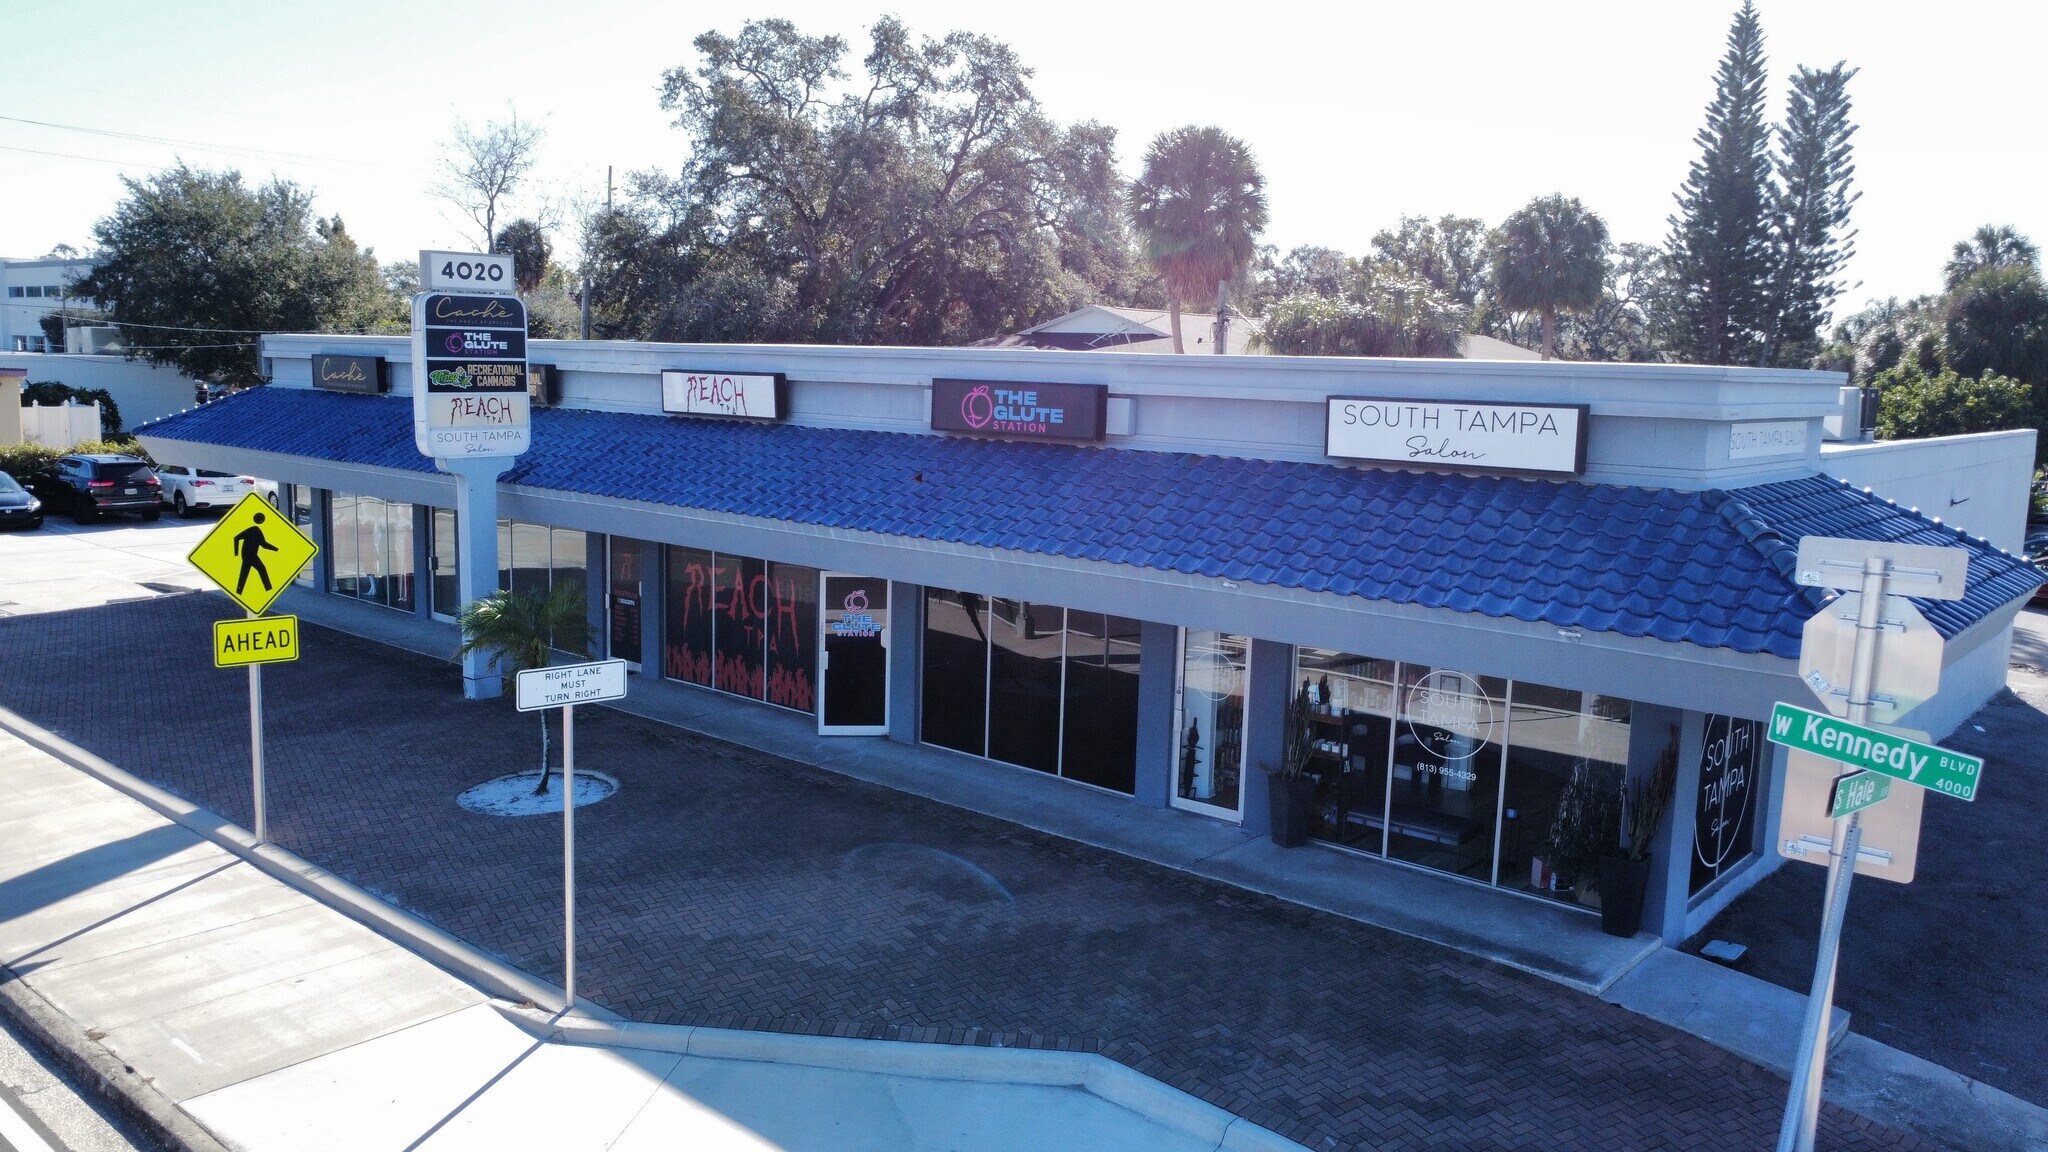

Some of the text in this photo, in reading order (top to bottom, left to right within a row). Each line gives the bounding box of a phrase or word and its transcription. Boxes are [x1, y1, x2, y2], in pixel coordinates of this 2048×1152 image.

[442, 261, 503, 281] 4020
[464, 332, 491, 341] THE
[464, 341, 508, 350] GLUTE
[467, 364, 524, 376] RECREATIONAL
[477, 375, 516, 387] CANNABIS
[687, 374, 747, 416] REACH
[994, 389, 1037, 406] THE
[450, 396, 513, 427] REACH
[993, 405, 1064, 424] GLUTE
[1343, 404, 1559, 436] SOUTH TAMPA
[437, 430, 521, 442] SOUTH TAMPA
[992, 420, 1046, 433] STATION
[465, 443, 496, 454] Salon
[1405, 435, 1487, 460] Salon
[682, 561, 799, 657] REACH
[842, 614, 871, 623] THE
[832, 622, 880, 631] GLUTE
[223, 630, 290, 653] AHEAD
[545, 667, 602, 680] RIGHT LANE
[561, 680, 586, 690] MUST
[545, 689, 601, 703] TURN RIGHT
[1420, 690, 1482, 714] SOUTH
[1420, 709, 1480, 733] TAMPA
[1433, 732, 1463, 744] Salon
[1775, 713, 1975, 780] W Kennedy BLVD
[1706, 724, 1750, 772] SOUTH
[1417, 762, 1477, 781] (813) 955-4329
[1704, 765, 1745, 811] TAMPA
[1835, 789, 1844, 810] S
[1846, 780, 1875, 809] Hale
[1936, 778, 1971, 797] 4000
